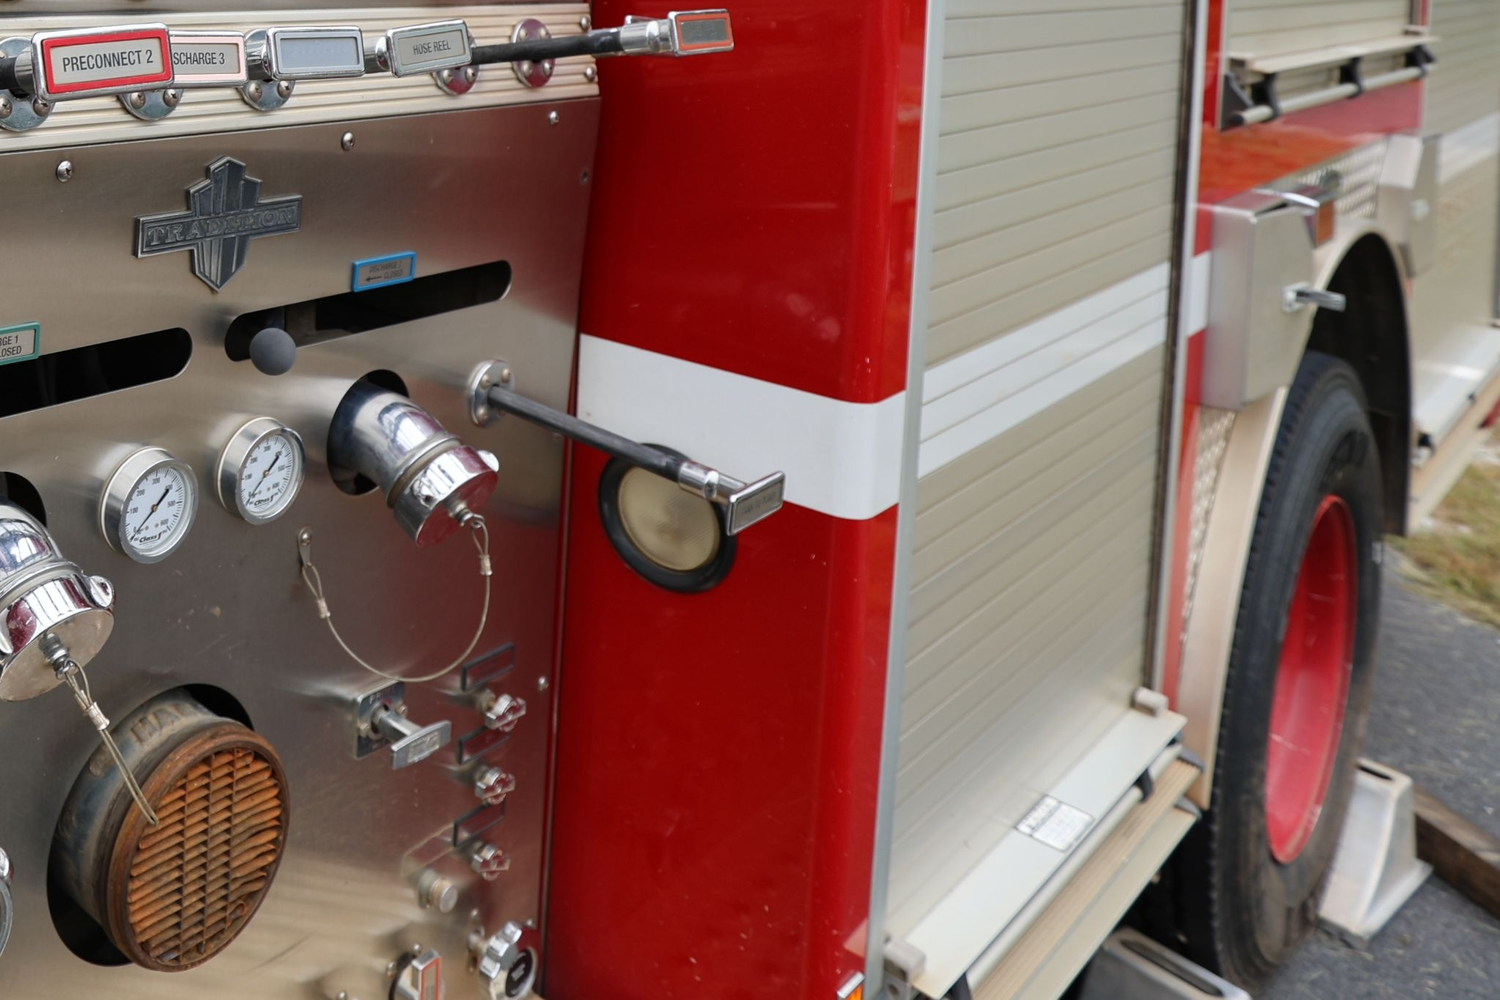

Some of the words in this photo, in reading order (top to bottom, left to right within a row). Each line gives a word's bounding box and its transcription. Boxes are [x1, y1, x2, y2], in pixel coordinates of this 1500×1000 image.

[413, 42, 432, 55] HOSE
[434, 40, 451, 52] REEL
[63, 50, 142, 72] PRECONNECT
[147, 50, 154, 64] 2
[173, 52, 217, 66] SCHARGE
[219, 53, 225, 65] 3
[149, 207, 297, 245] TRADITION
[15, 335, 19, 345] 1
